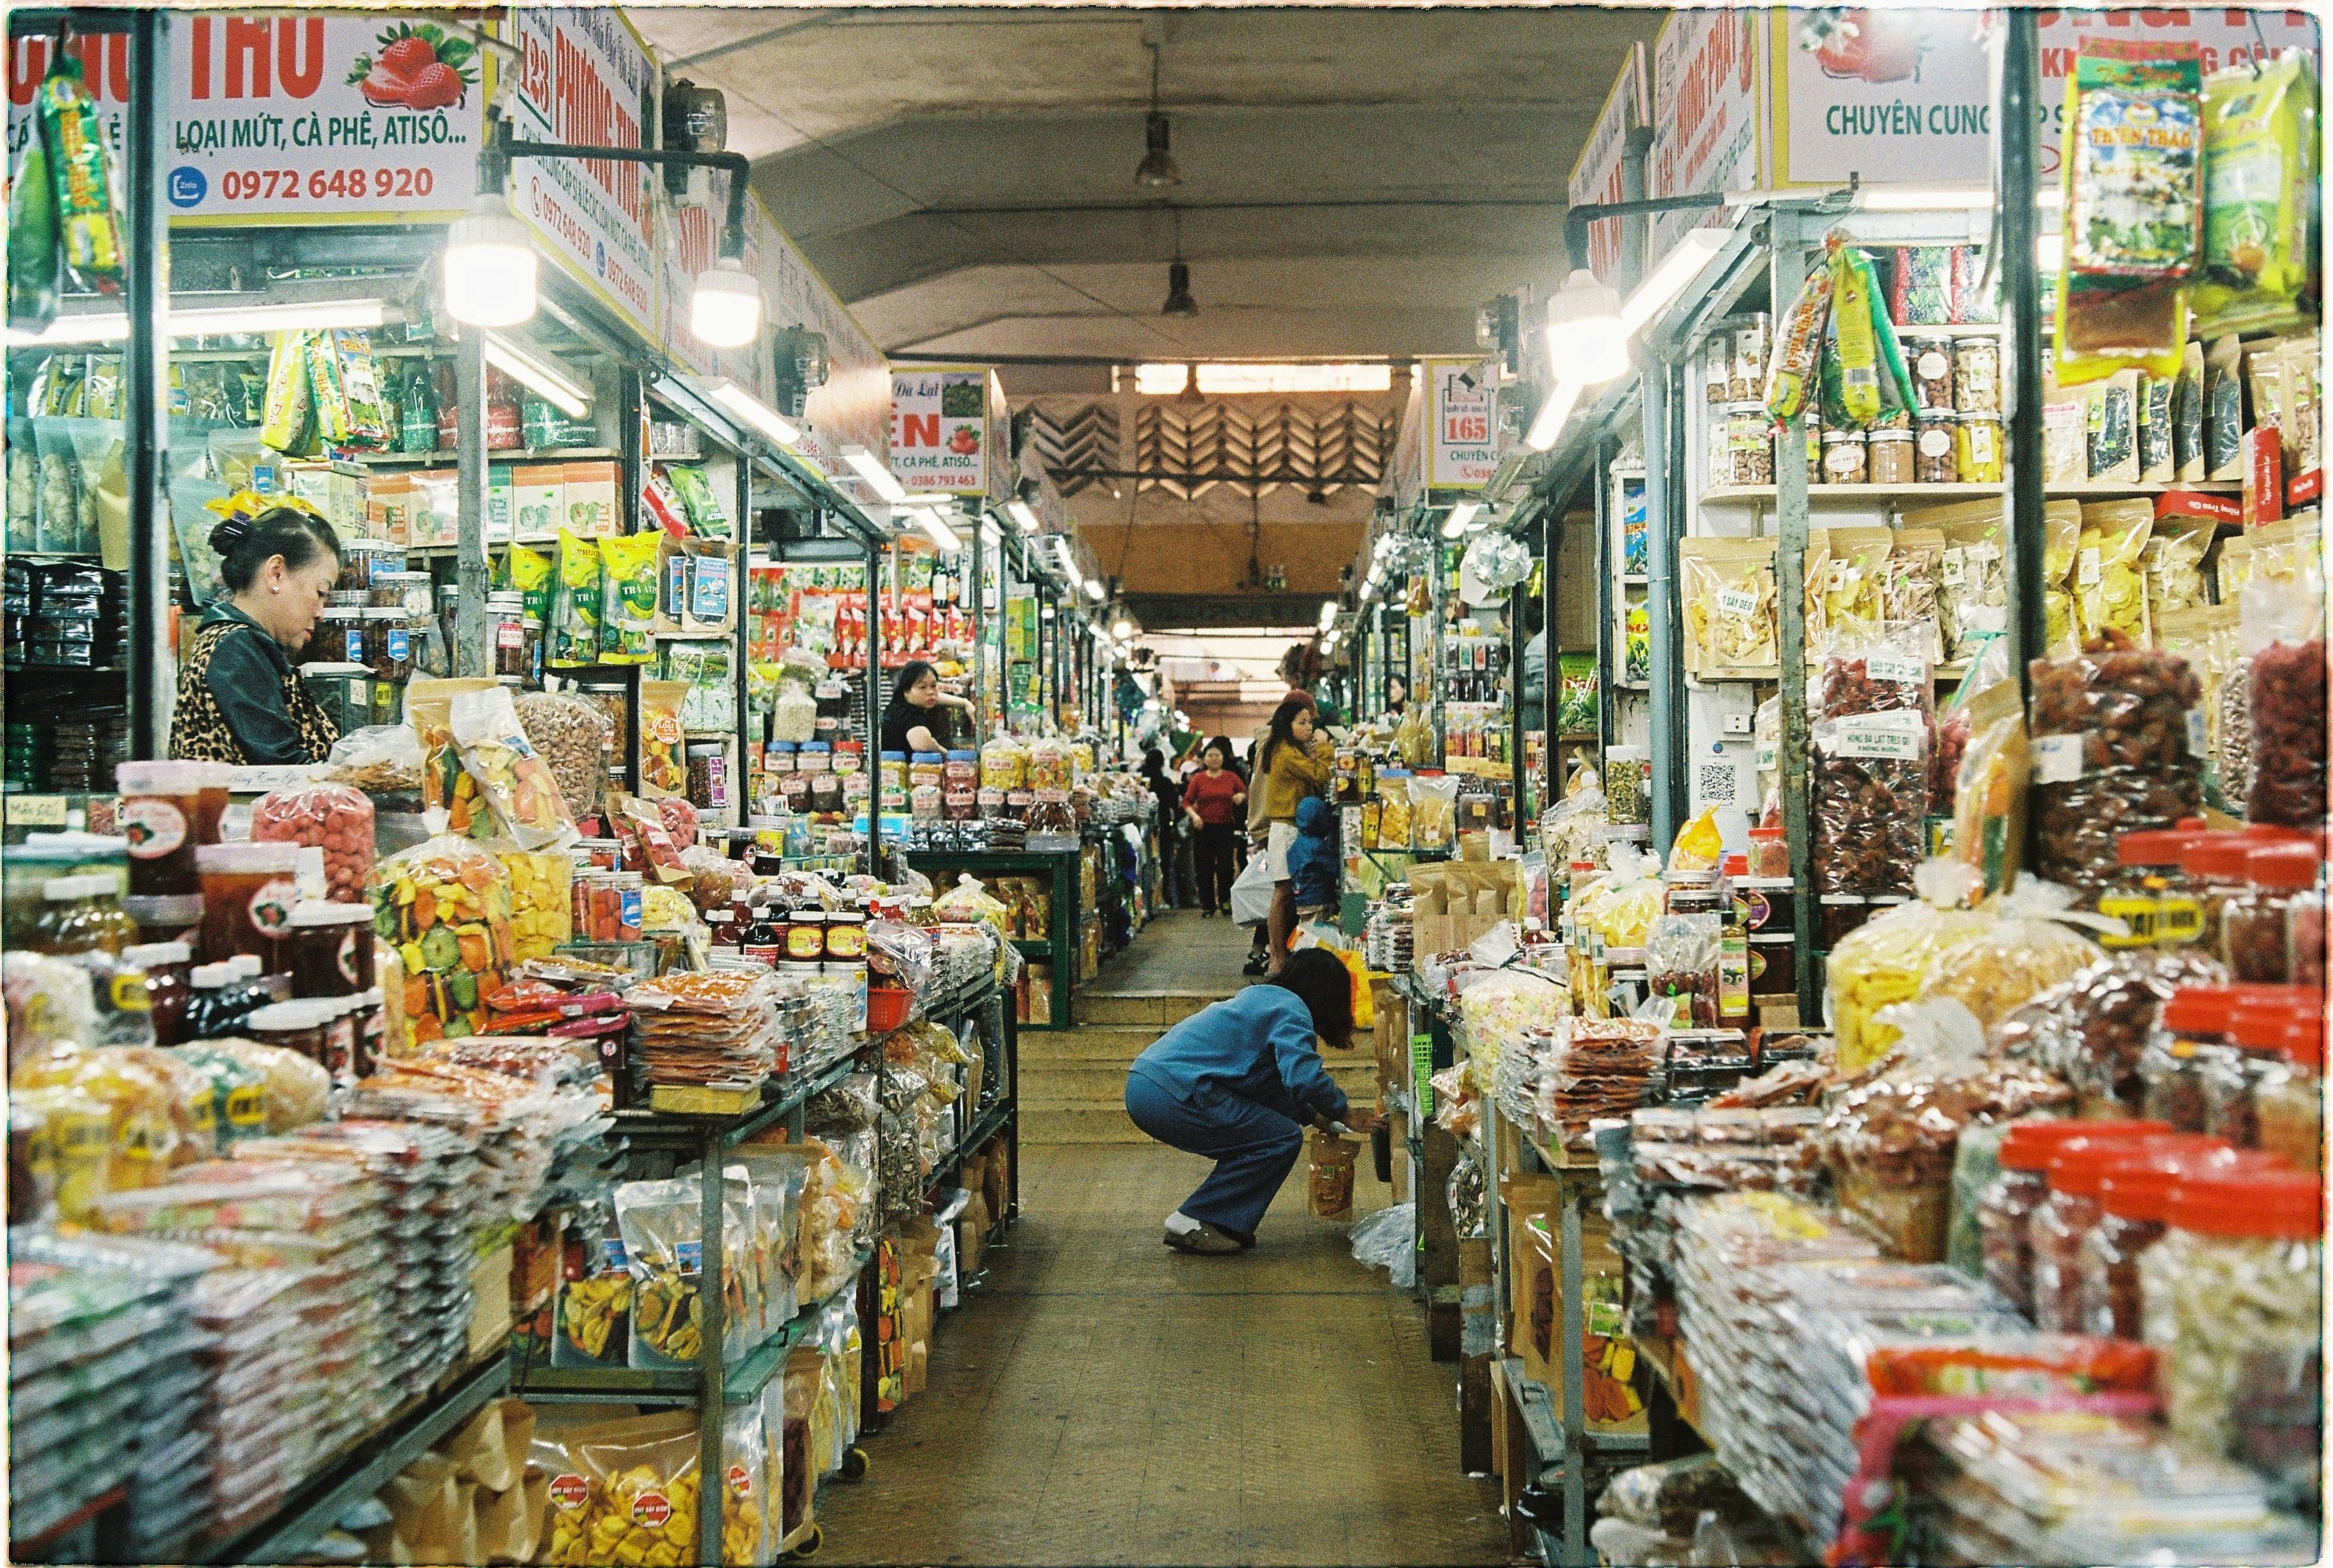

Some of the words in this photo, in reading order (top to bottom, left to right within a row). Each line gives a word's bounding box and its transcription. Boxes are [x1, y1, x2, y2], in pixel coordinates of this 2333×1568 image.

[521, 30, 549, 113] 123
[1826, 98, 1922, 135] CHUYÊN
[176, 119, 226, 157] LOẠI
[232, 112, 286, 151] MỨT,
[292, 110, 321, 147] CÀ
[328, 111, 378, 150] PHÊ,
[222, 169, 299, 200] 0972
[308, 167, 367, 198] 648
[375, 167, 433, 197] 920
[543, 192, 562, 233] 0972
[562, 211, 576, 247] 648
[577, 225, 590, 260] 920
[1447, 417, 1487, 441] 165
[1450, 449, 1488, 461] CHUYÊN
[911, 475, 936, 485] 0386
[958, 475, 976, 485] 463
[2202, 503, 2220, 513] Treo
[622, 583, 641, 595] TRÀ
[1726, 594, 1738, 607] SẤY
